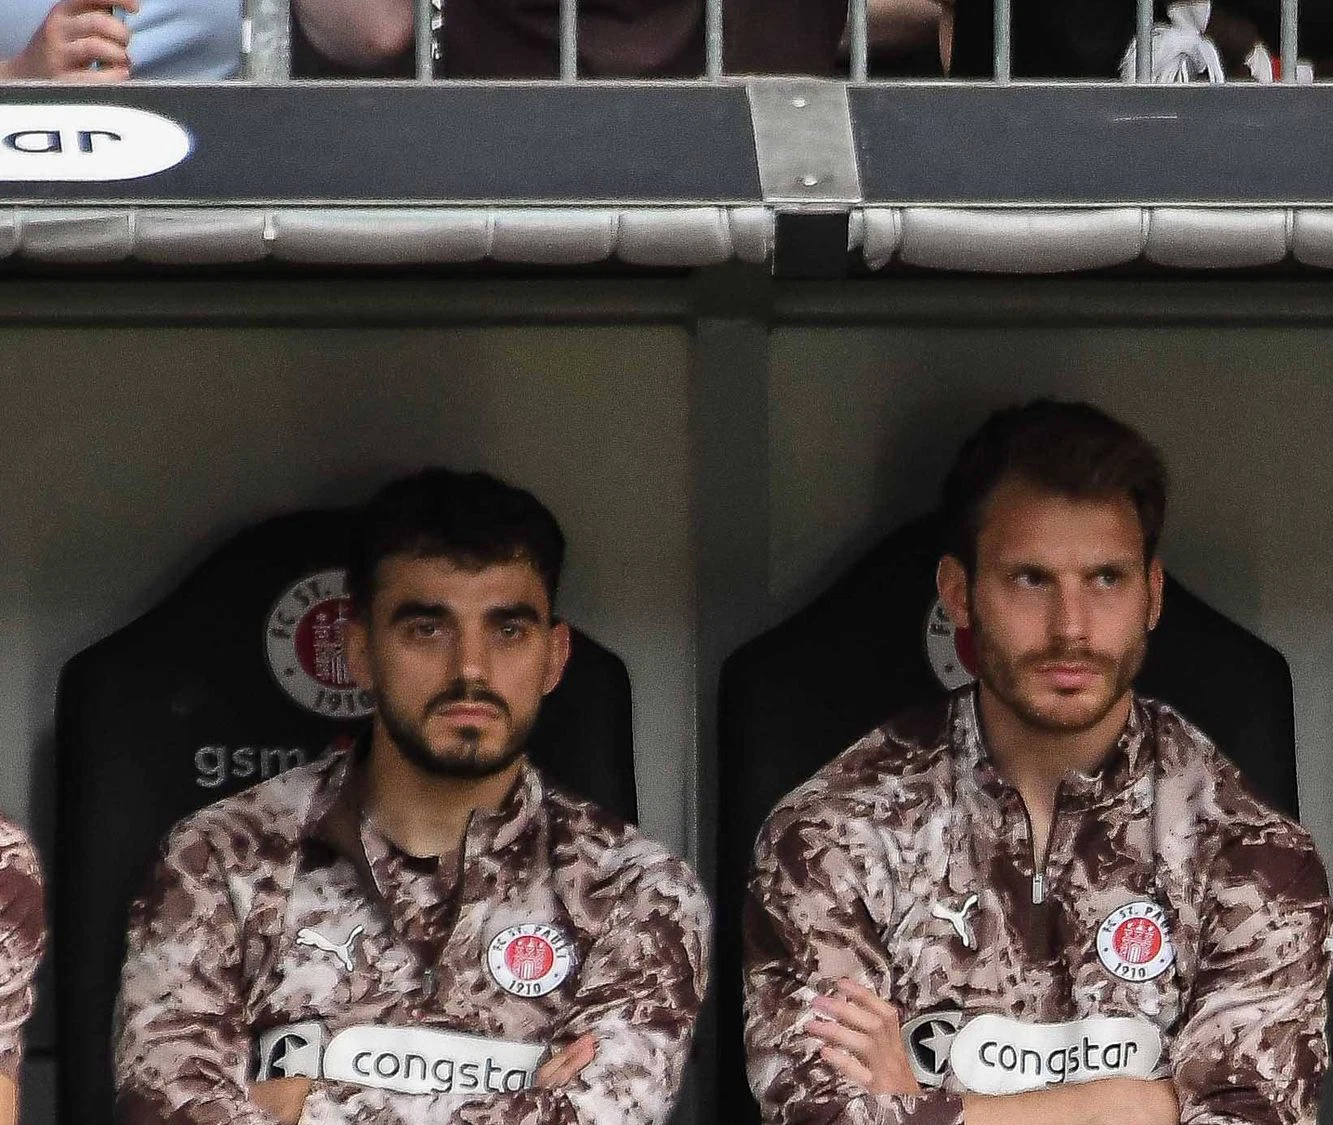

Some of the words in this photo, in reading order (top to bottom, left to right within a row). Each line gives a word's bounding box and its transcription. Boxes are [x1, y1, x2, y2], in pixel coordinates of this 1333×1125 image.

[2, 131, 122, 153] ar
[533, 926, 568, 958] PAULI
[1114, 962, 1146, 979] 1910
[509, 979, 542, 995] 1910
[979, 1036, 1139, 1086] congstar
